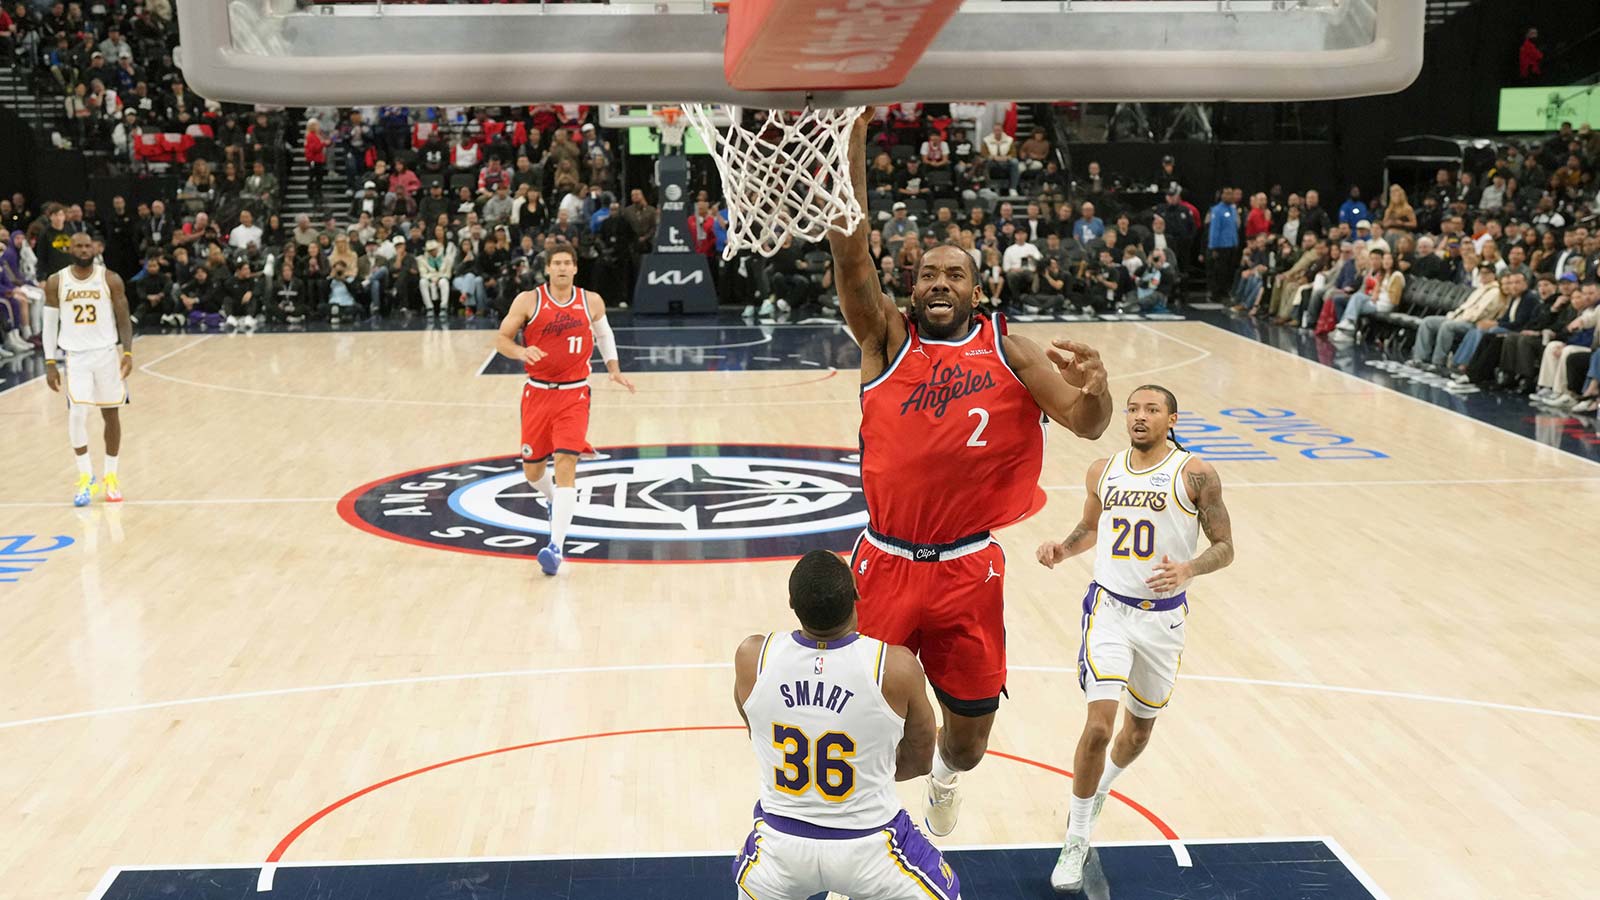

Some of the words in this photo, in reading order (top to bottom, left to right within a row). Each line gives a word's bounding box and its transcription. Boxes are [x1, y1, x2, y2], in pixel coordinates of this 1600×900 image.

[647, 269, 704, 286] KIA
[65, 288, 101, 302] LAKERS
[73, 303, 97, 325] 23
[567, 335, 583, 354] 11
[930, 358, 965, 387] Los
[900, 370, 997, 418] Angeles
[966, 407, 990, 447] 2
[1103, 485, 1168, 512] LAKERS
[1111, 517, 1156, 561] 20
[916, 548, 936, 559] Clips
[779, 680, 855, 715] SMART
[771, 721, 857, 803] 36
